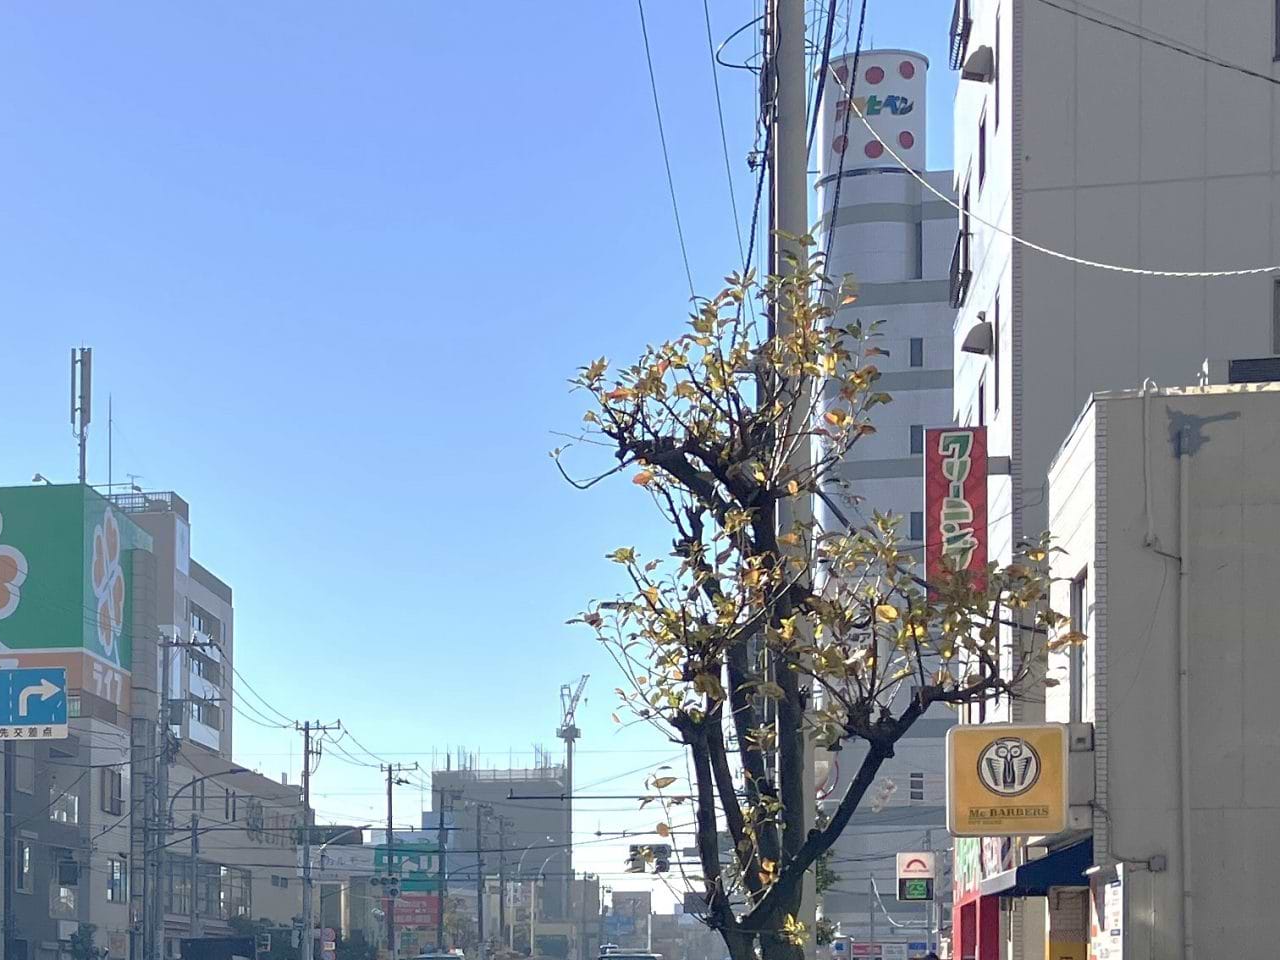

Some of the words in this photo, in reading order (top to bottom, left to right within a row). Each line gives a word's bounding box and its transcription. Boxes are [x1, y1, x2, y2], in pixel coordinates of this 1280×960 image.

[92, 661, 123, 705] ライフ
[989, 807, 1050, 817] BARBERS
